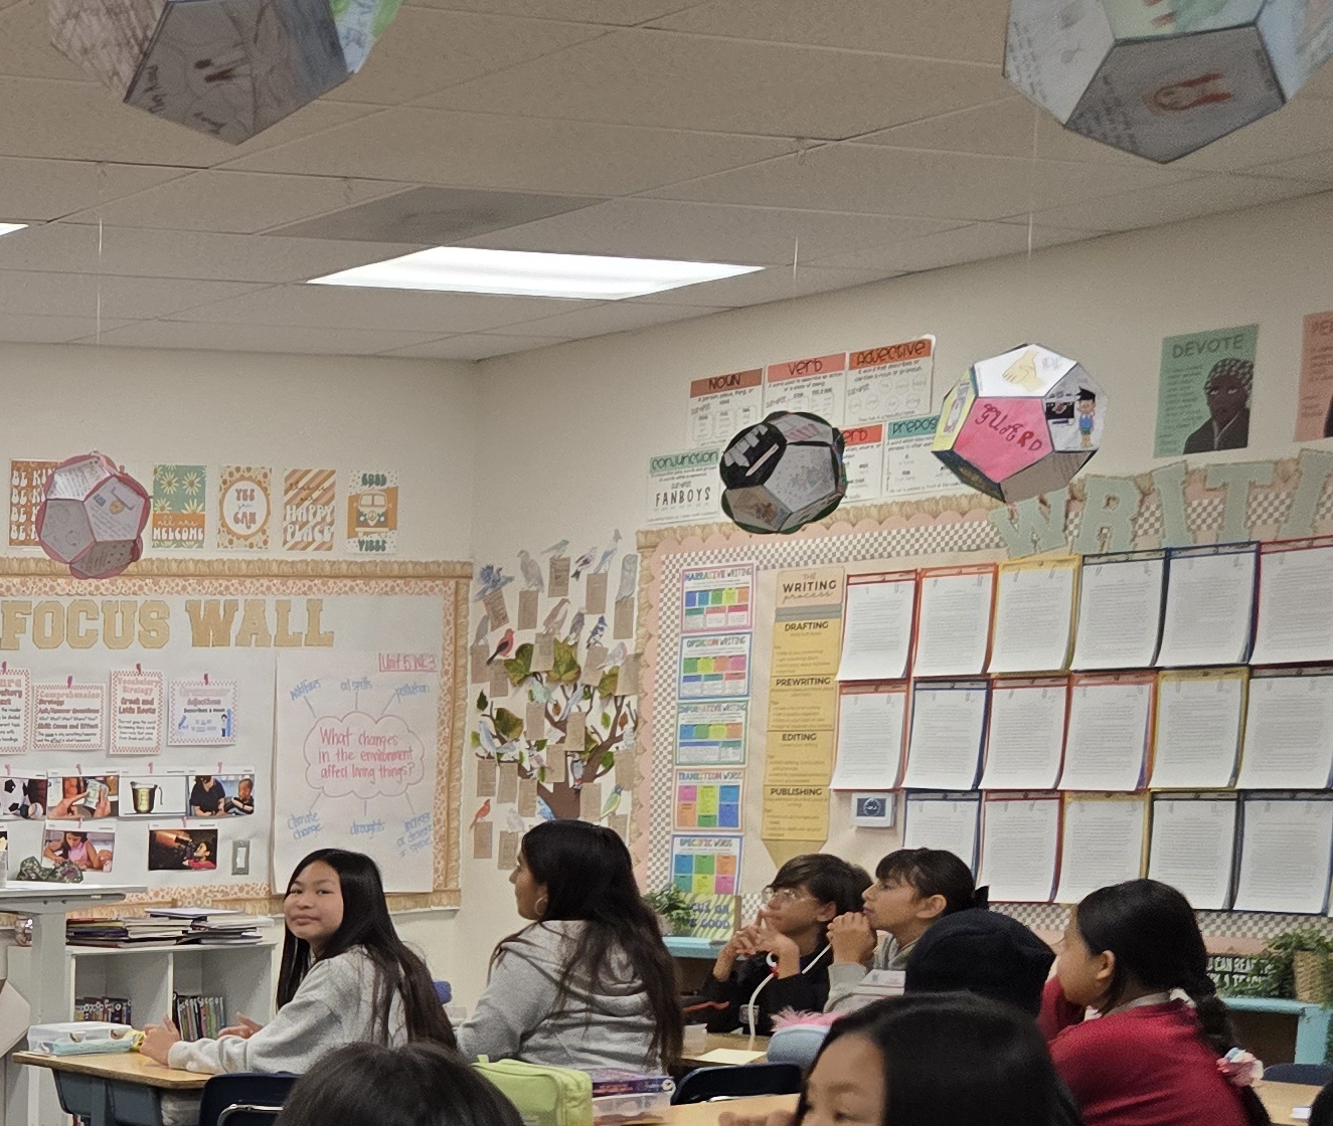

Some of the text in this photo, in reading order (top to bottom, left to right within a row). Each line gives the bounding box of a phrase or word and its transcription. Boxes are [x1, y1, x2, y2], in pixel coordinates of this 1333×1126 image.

[1171, 333, 1245, 359] DEVOTE
[708, 374, 742, 391] NOUN
[11, 470, 28, 487] BE
[655, 486, 711, 507] FANBOYS
[286, 503, 334, 522] HAPPY
[152, 527, 204, 541] WELCOME
[286, 524, 333, 543] PLACE
[782, 579, 837, 594] WRITING
[0, 599, 335, 651] FOCUS WALL
[784, 621, 829, 632] DRAFTING
[775, 677, 831, 687] PREWRITING
[319, 726, 398, 749] What changes
[781, 733, 817, 742] EDITING
[318, 751, 330, 764] in
[336, 748, 356, 761] the
[351, 763, 376, 784] living
[378, 762, 416, 784] things?
[770, 787, 823, 797] PUBLISHING
